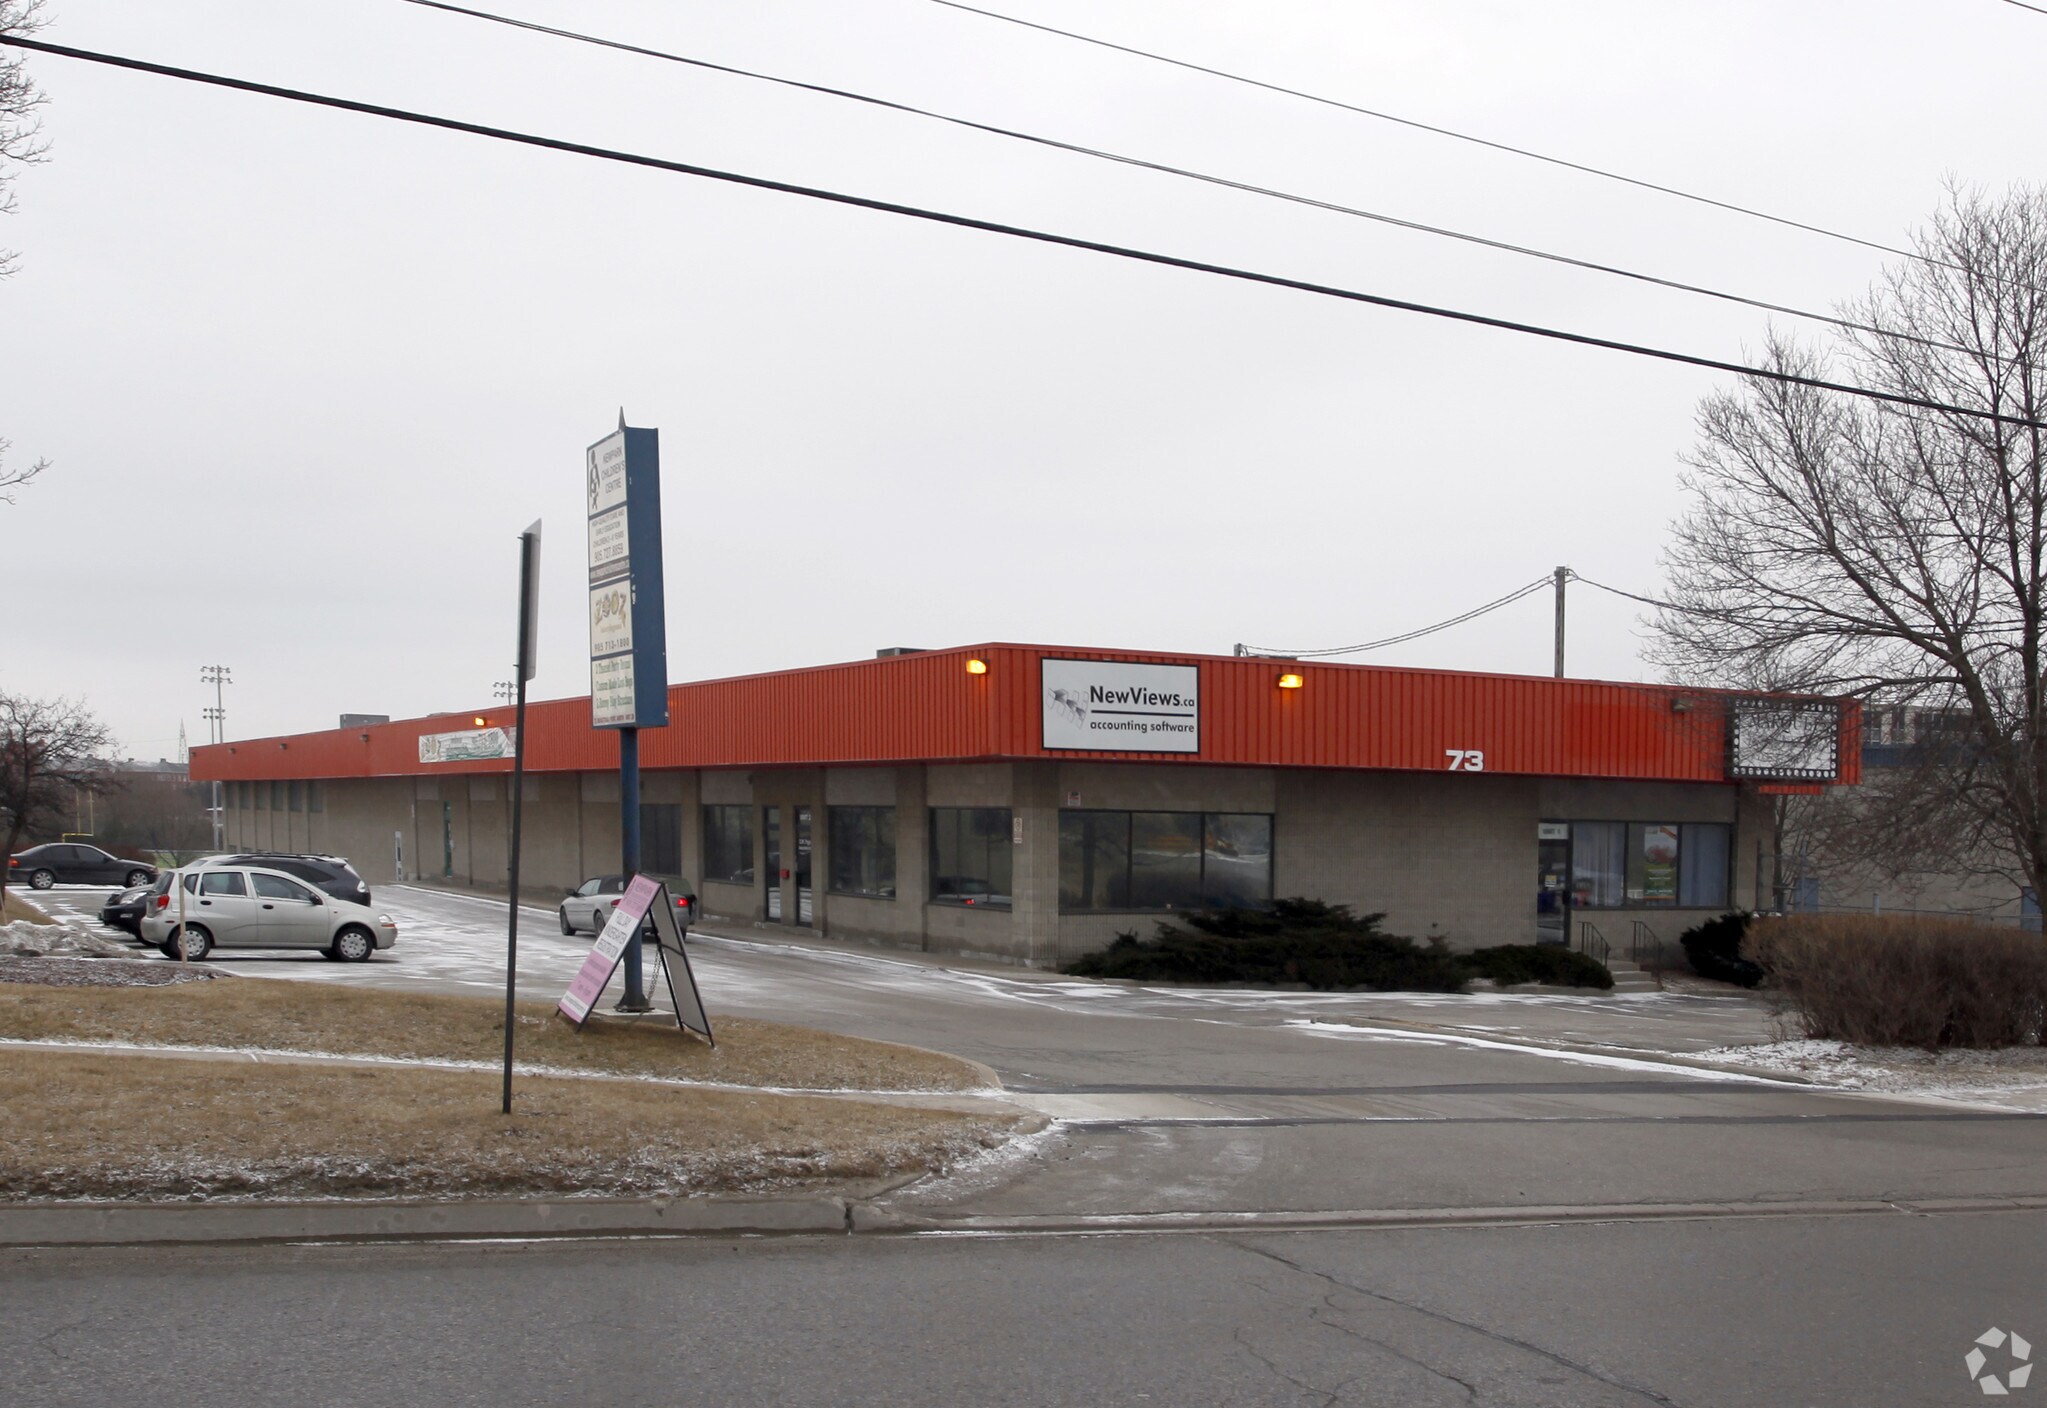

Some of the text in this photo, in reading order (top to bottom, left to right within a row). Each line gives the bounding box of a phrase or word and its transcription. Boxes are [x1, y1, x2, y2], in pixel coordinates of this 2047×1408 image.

[601, 460, 625, 481] CHILDREN'S
[605, 477, 622, 494] CENTRE
[1090, 720, 1195, 733] accounting software
[1445, 749, 1484, 772] 73
